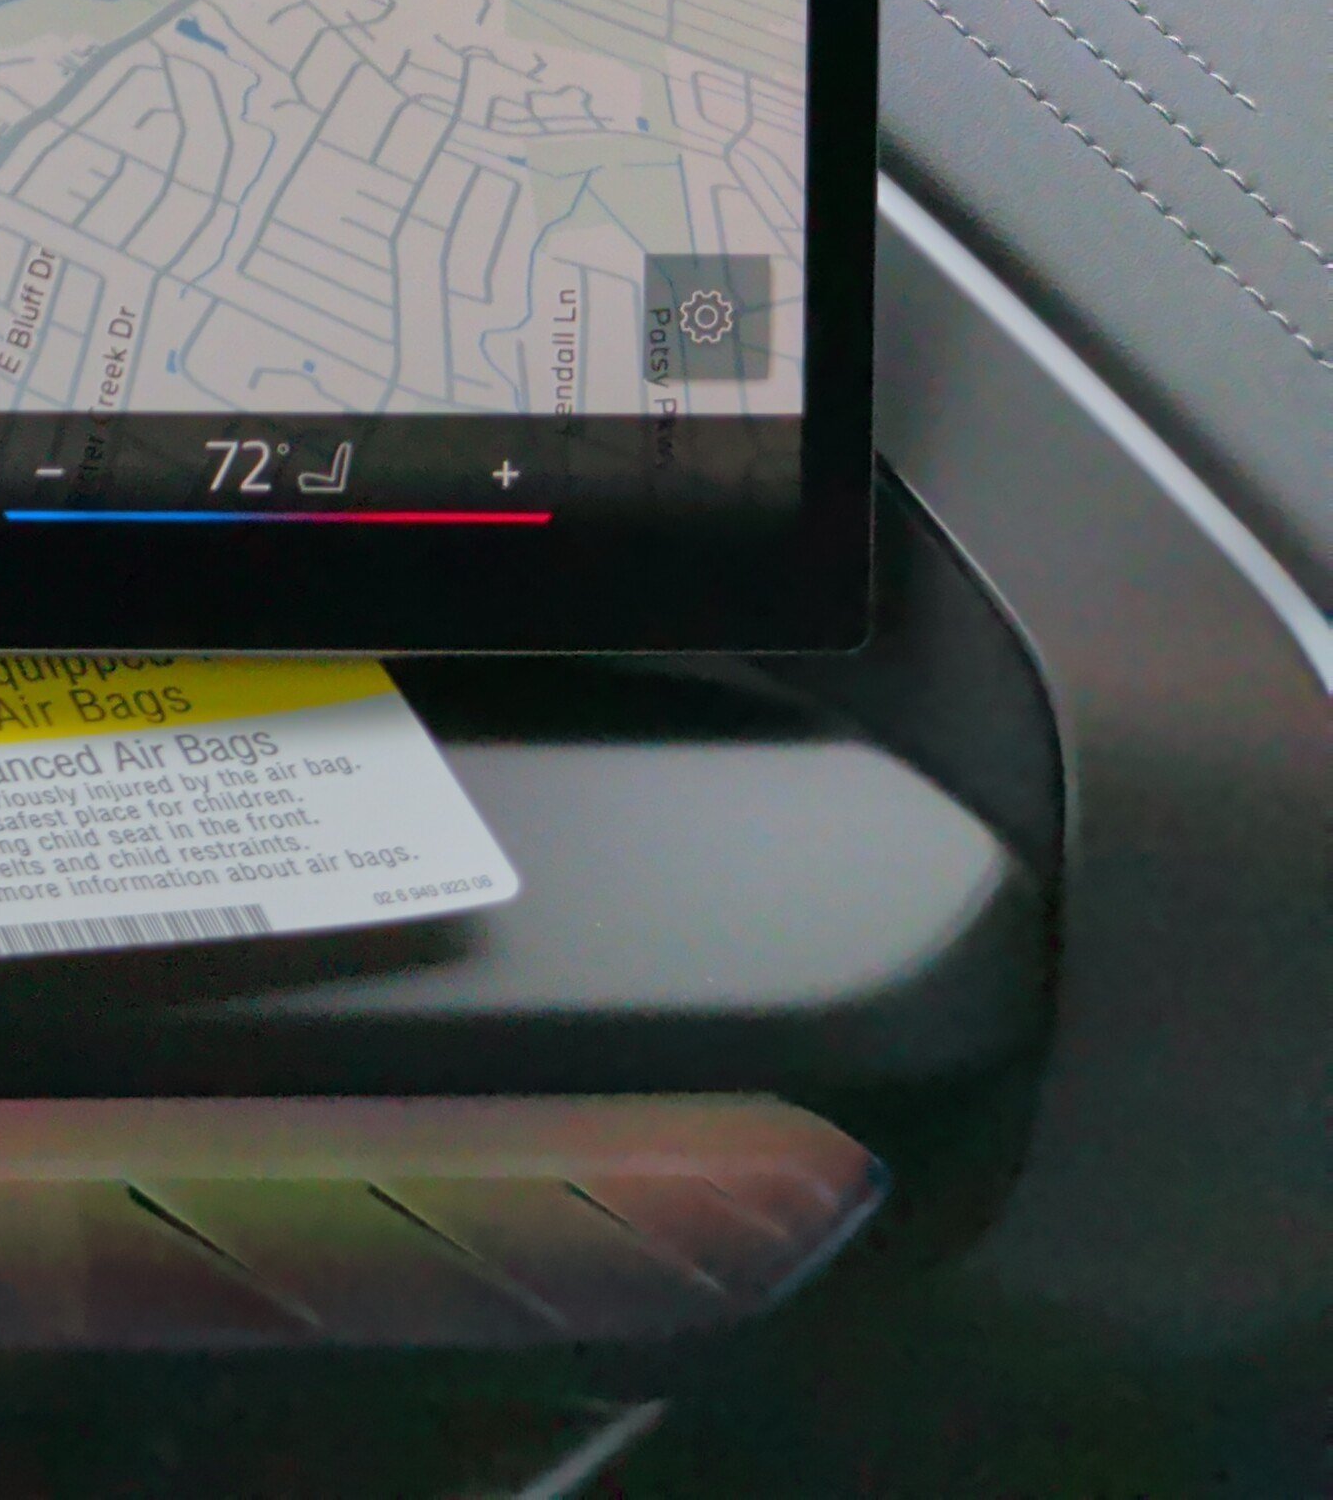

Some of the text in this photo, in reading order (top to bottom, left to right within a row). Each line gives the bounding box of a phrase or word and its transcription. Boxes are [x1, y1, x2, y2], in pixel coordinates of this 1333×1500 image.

[6, 280, 45, 349] Bluff
[28, 246, 57, 281] Dr
[108, 305, 139, 340] Dr
[551, 288, 577, 435] endall Ln
[648, 306, 672, 389] Patsy
[68, 685, 192, 724] Bags
[113, 736, 166, 773] Air
[174, 731, 280, 766] Bags
[83, 775, 175, 802] injured
[178, 773, 211, 795] by
[217, 768, 259, 787] the
[264, 762, 298, 782] air
[303, 755, 361, 776] bag.
[37, 828, 101, 851] child
[107, 823, 164, 845] seat
[166, 820, 194, 840] in
[198, 817, 241, 836] the
[245, 807, 321, 832] front.
[74, 804, 141, 829] place
[146, 798, 183, 818] for
[192, 787, 305, 814] children.
[52, 851, 101, 874] and
[108, 845, 172, 869] child
[178, 834, 310, 863] restraints.
[65, 866, 220, 897] information
[226, 857, 302, 883] about
[305, 851, 340, 875] air
[344, 845, 420, 870] bags.
